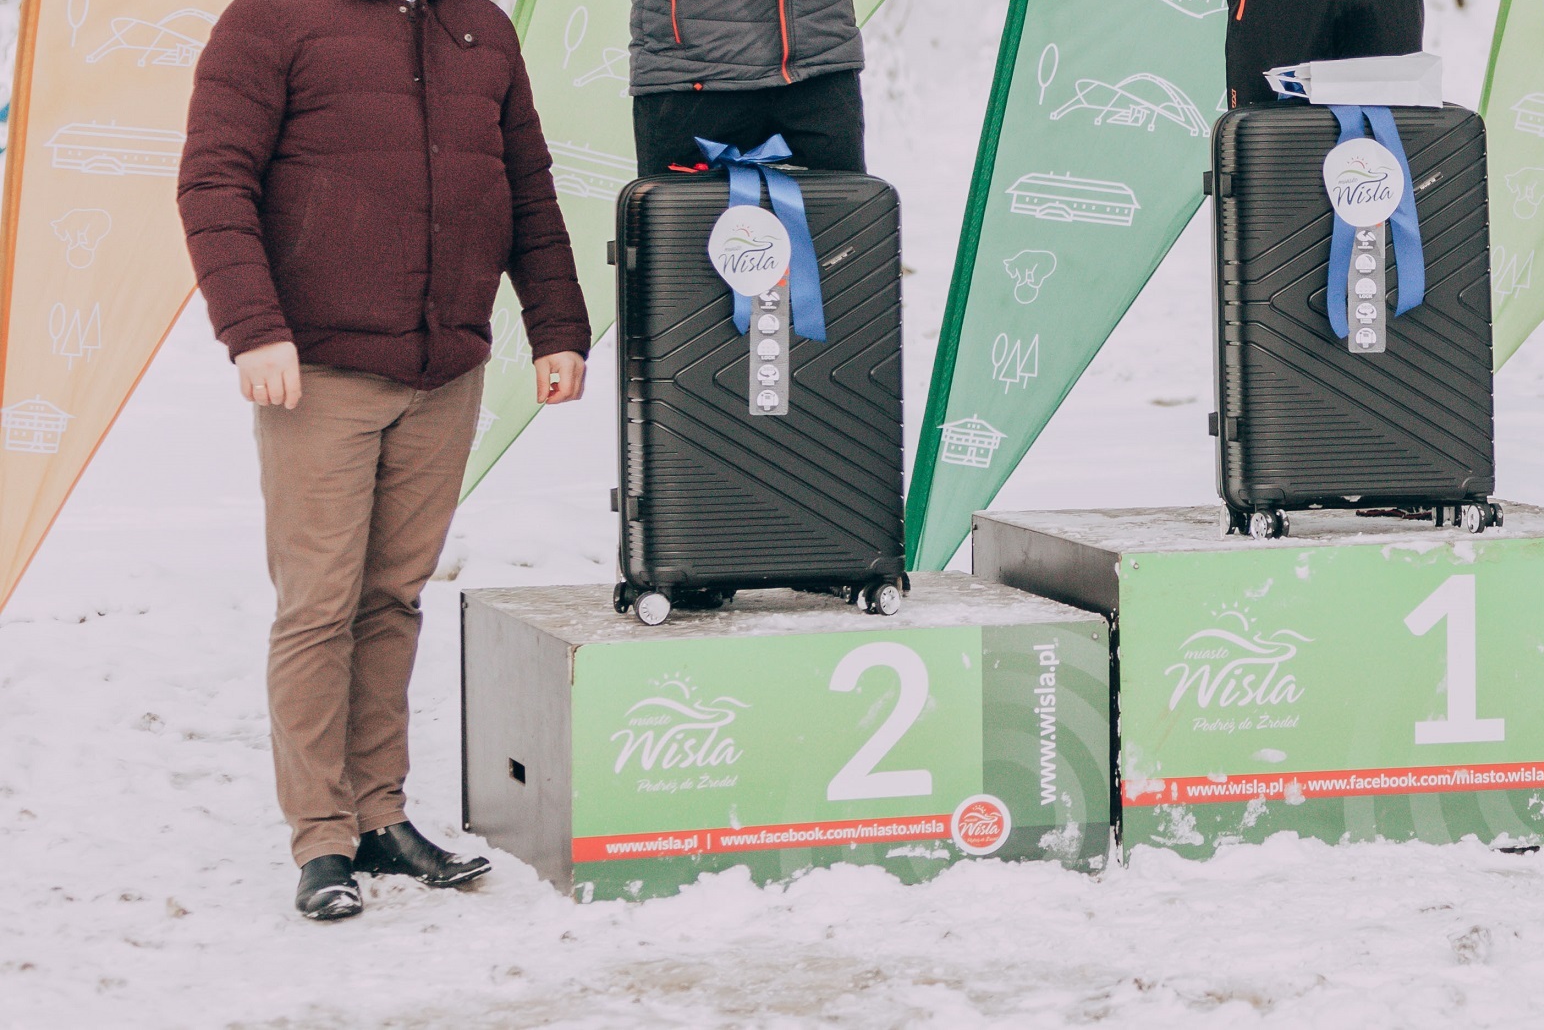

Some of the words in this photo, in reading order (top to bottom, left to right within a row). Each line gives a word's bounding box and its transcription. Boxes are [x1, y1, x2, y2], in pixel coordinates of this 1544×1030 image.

[1184, 647, 1229, 659] miasto
[1404, 574, 1505, 744] 1
[629, 715, 672, 726] miasto
[826, 641, 932, 801] 2
[1038, 642, 1060, 806] www.wisla.pl
[1238, 717, 1252, 730] do
[1187, 778, 1283, 797] www.wisla.pl
[1308, 768, 1544, 792] www.facebook.com/miasto.wisla
[606, 835, 698, 854] www.wisla.pl
[721, 819, 945, 848] www.facebook.com/miasto.wisla
